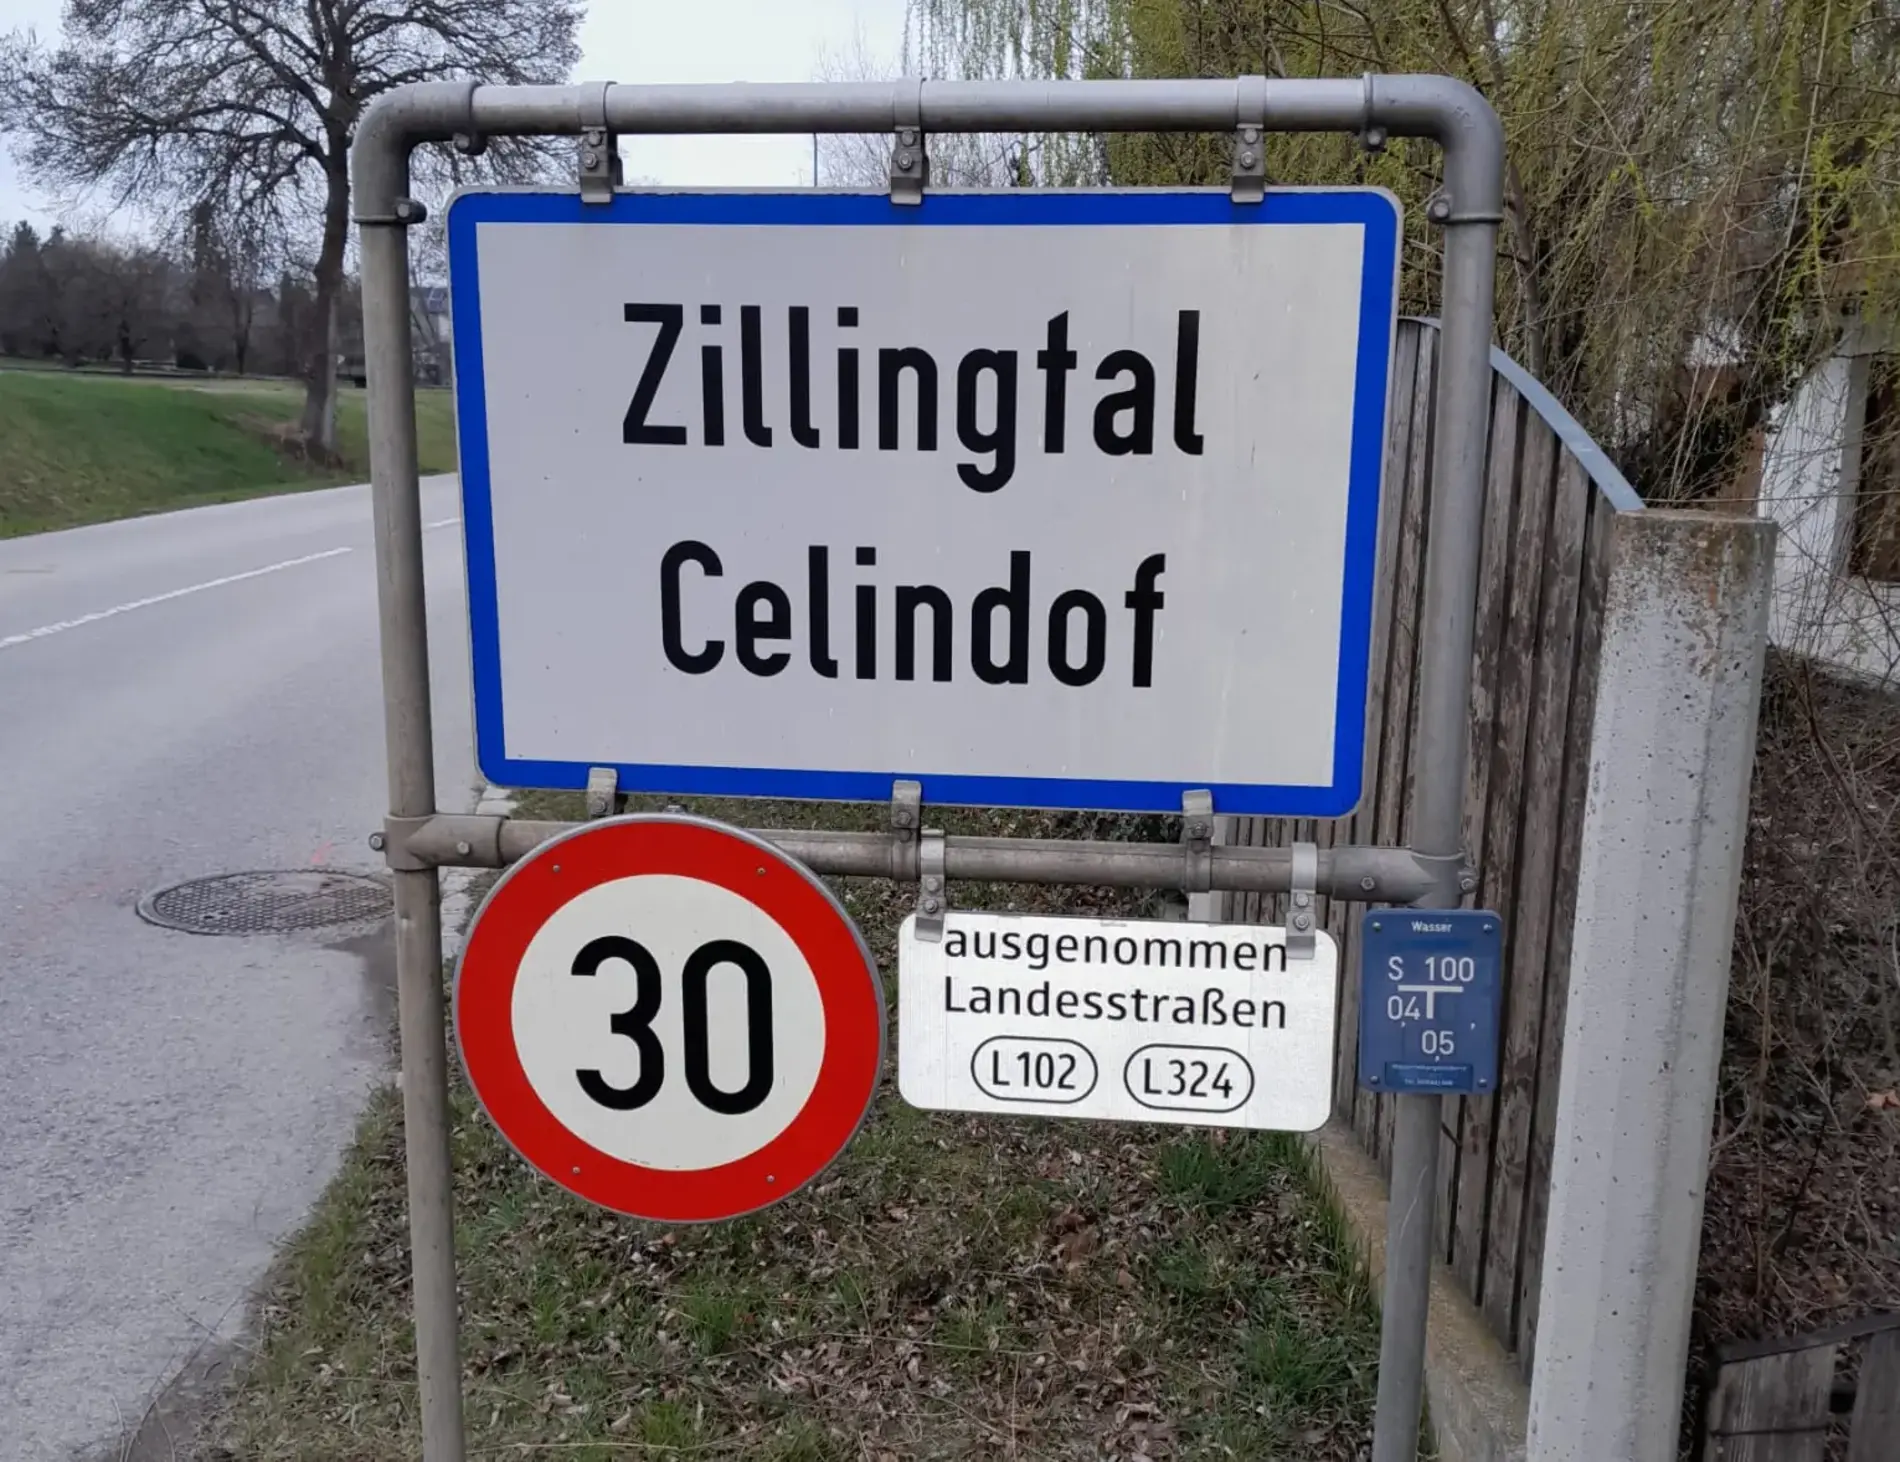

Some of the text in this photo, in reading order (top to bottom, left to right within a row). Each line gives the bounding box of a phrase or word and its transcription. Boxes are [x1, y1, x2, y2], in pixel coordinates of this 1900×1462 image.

[622, 302, 1205, 494] Zillingtal
[660, 539, 1166, 688] Celindof
[944, 929, 1288, 972] ausgenommen
[1411, 920, 1452, 933] Wasser
[1387, 956, 1475, 982] S 100
[571, 935, 774, 1115] 30
[944, 975, 1287, 1029] Landesstraßen
[992, 1050, 1233, 1099] L102 L324
